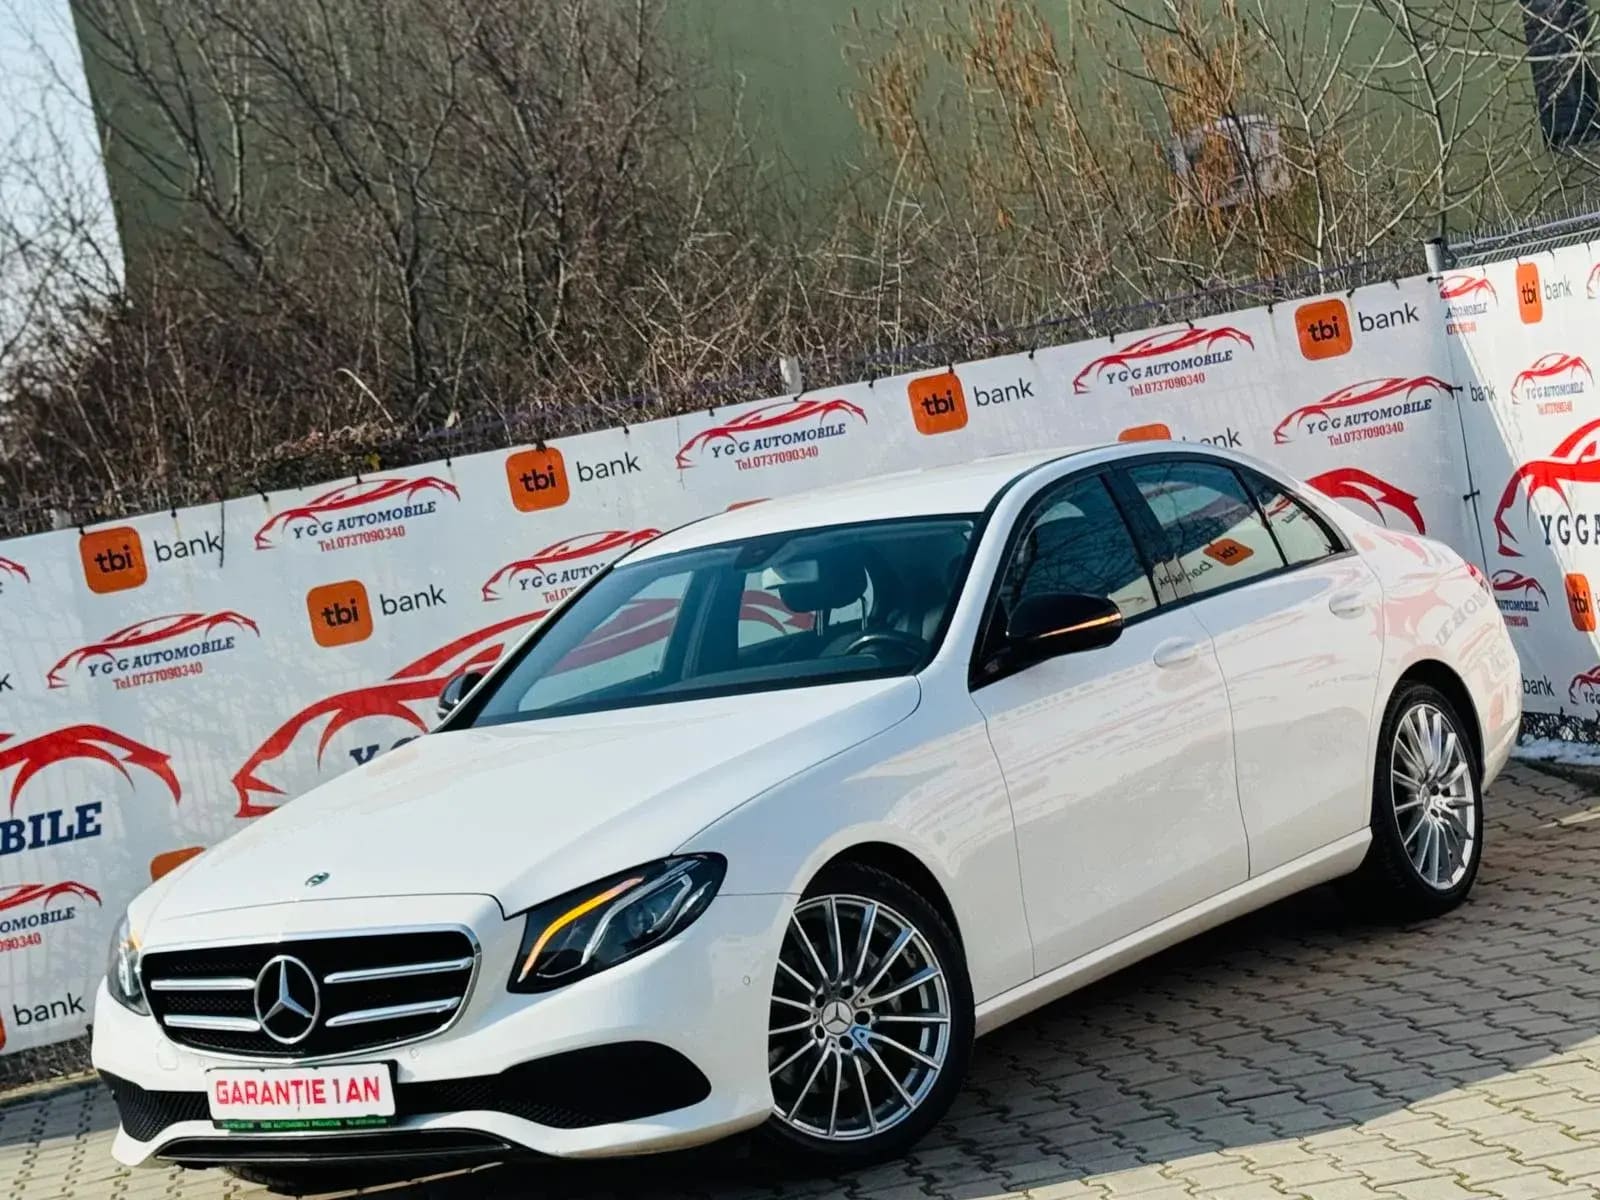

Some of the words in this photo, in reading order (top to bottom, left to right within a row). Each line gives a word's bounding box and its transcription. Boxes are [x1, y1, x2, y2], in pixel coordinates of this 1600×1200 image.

[1521, 281, 1537, 305] tbi
[1544, 274, 1573, 300] bank
[1308, 315, 1340, 342] tbi
[1358, 302, 1420, 332] bank
[1144, 350, 1233, 378] AUTOMOBILE
[921, 390, 955, 416] tbi
[973, 378, 1035, 407] bank
[1344, 399, 1433, 427] AUTOMOBILE
[753, 423, 847, 452] AUTOMOBILE
[520, 465, 556, 493] tbi
[576, 451, 641, 482] bank
[336, 501, 437, 532] AUTOMOBILE
[94, 544, 134, 573] tbi
[153, 531, 222, 563] bank
[321, 598, 359, 627] tbi
[380, 584, 448, 616] bank
[132, 636, 235, 669] AUTOMOBILE
[13, 992, 86, 1026] bank
[346, 1076, 381, 1103] AN
